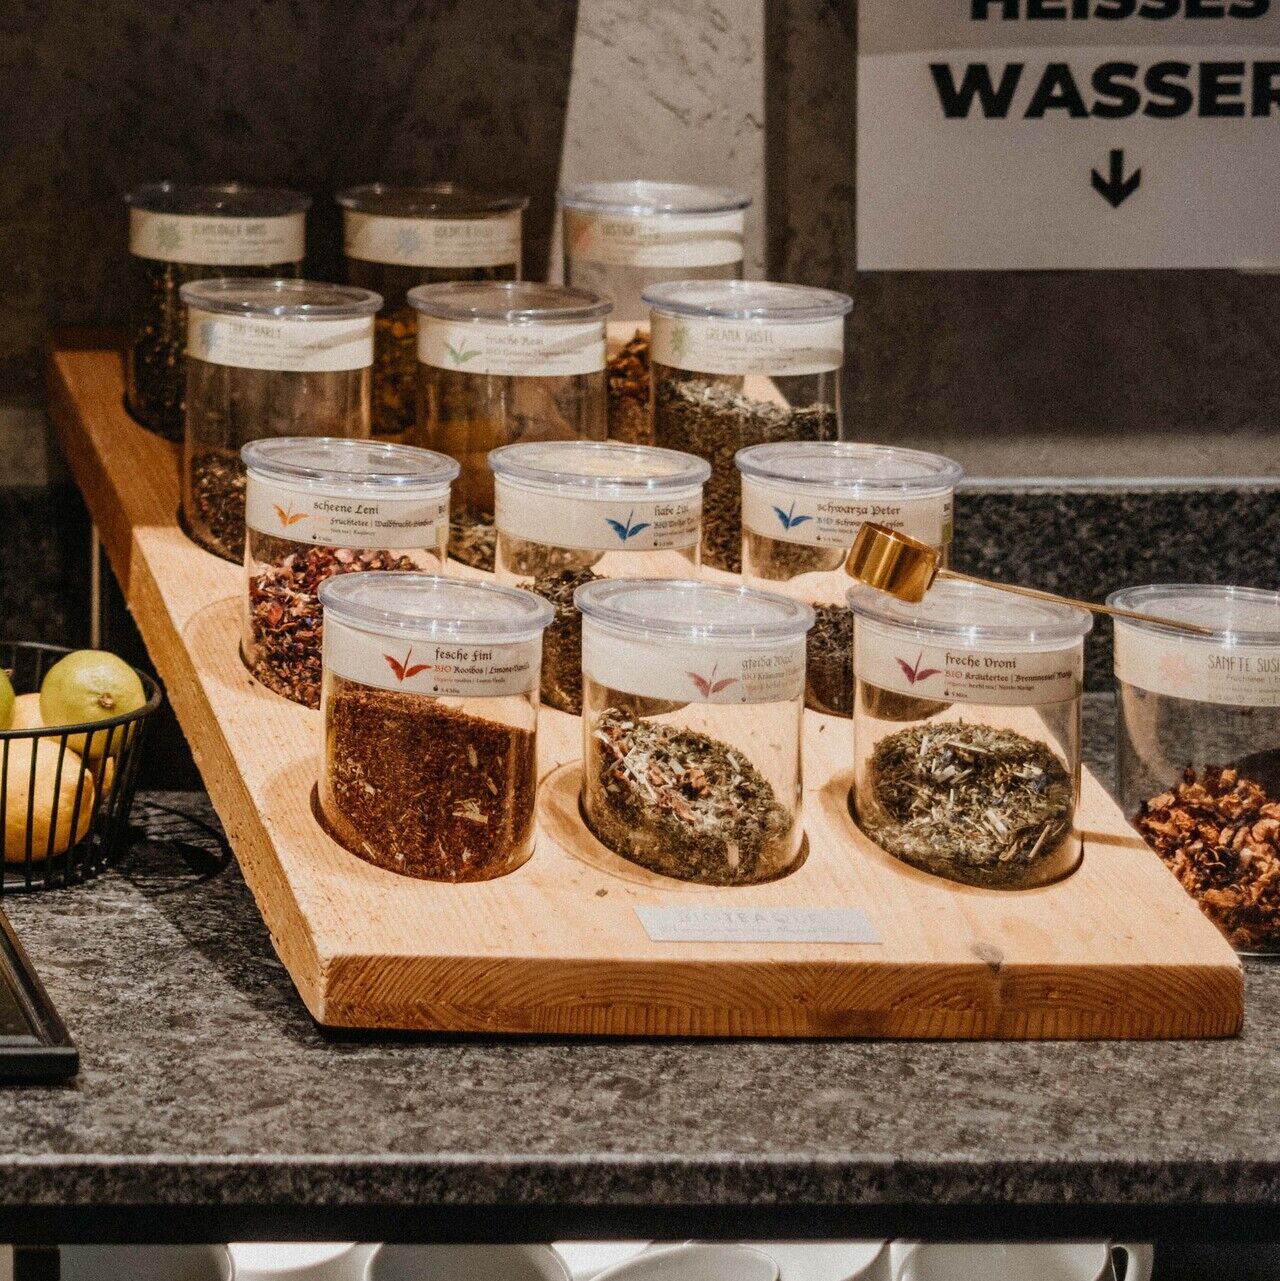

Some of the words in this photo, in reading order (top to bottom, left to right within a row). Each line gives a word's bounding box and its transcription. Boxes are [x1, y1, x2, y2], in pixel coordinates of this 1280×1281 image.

[313, 500, 352, 514] scheene
[355, 503, 379, 515] Leni
[816, 501, 868, 516] schwarza
[870, 505, 901, 516] Peter
[434, 647, 468, 661] fesche
[470, 649, 492, 662] Fini
[945, 652, 981, 668] freche
[1208, 654, 1252, 672] SANFTE
[945, 671, 963, 680] BIO
[965, 671, 1009, 682] Kräutertee
